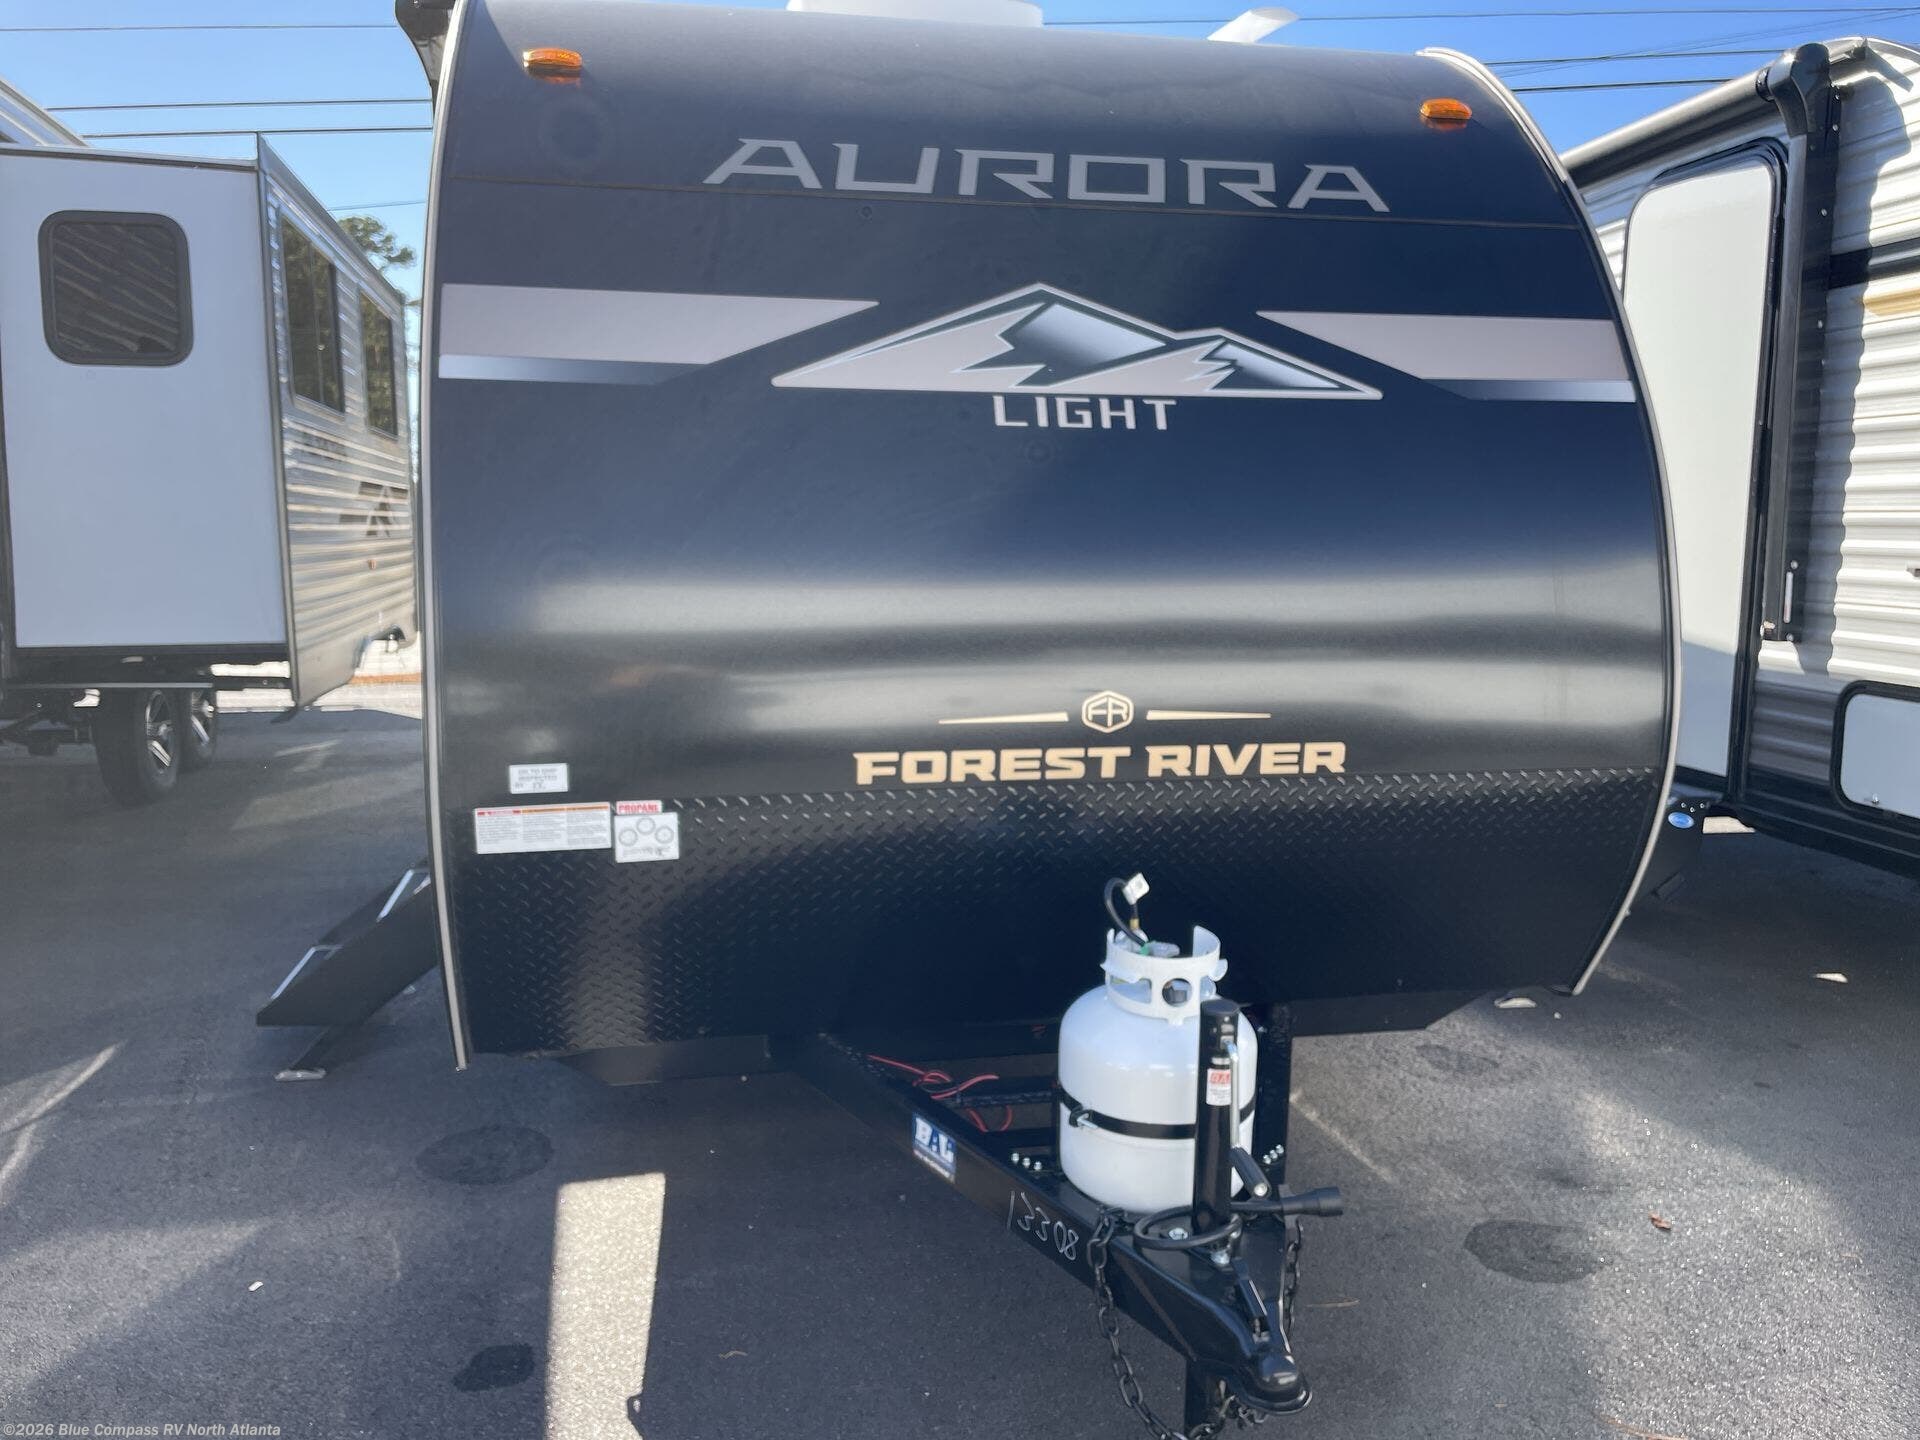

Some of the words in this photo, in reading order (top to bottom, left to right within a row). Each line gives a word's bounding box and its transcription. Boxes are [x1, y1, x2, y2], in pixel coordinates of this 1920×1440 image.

[703, 137, 1391, 213] AURORA
[992, 394, 1177, 430] LIGHT
[852, 746, 1131, 785] FOREST
[1146, 741, 1347, 777] RIVER
[618, 803, 659, 813] PROPANE
[1006, 1190, 1080, 1261] 13308
